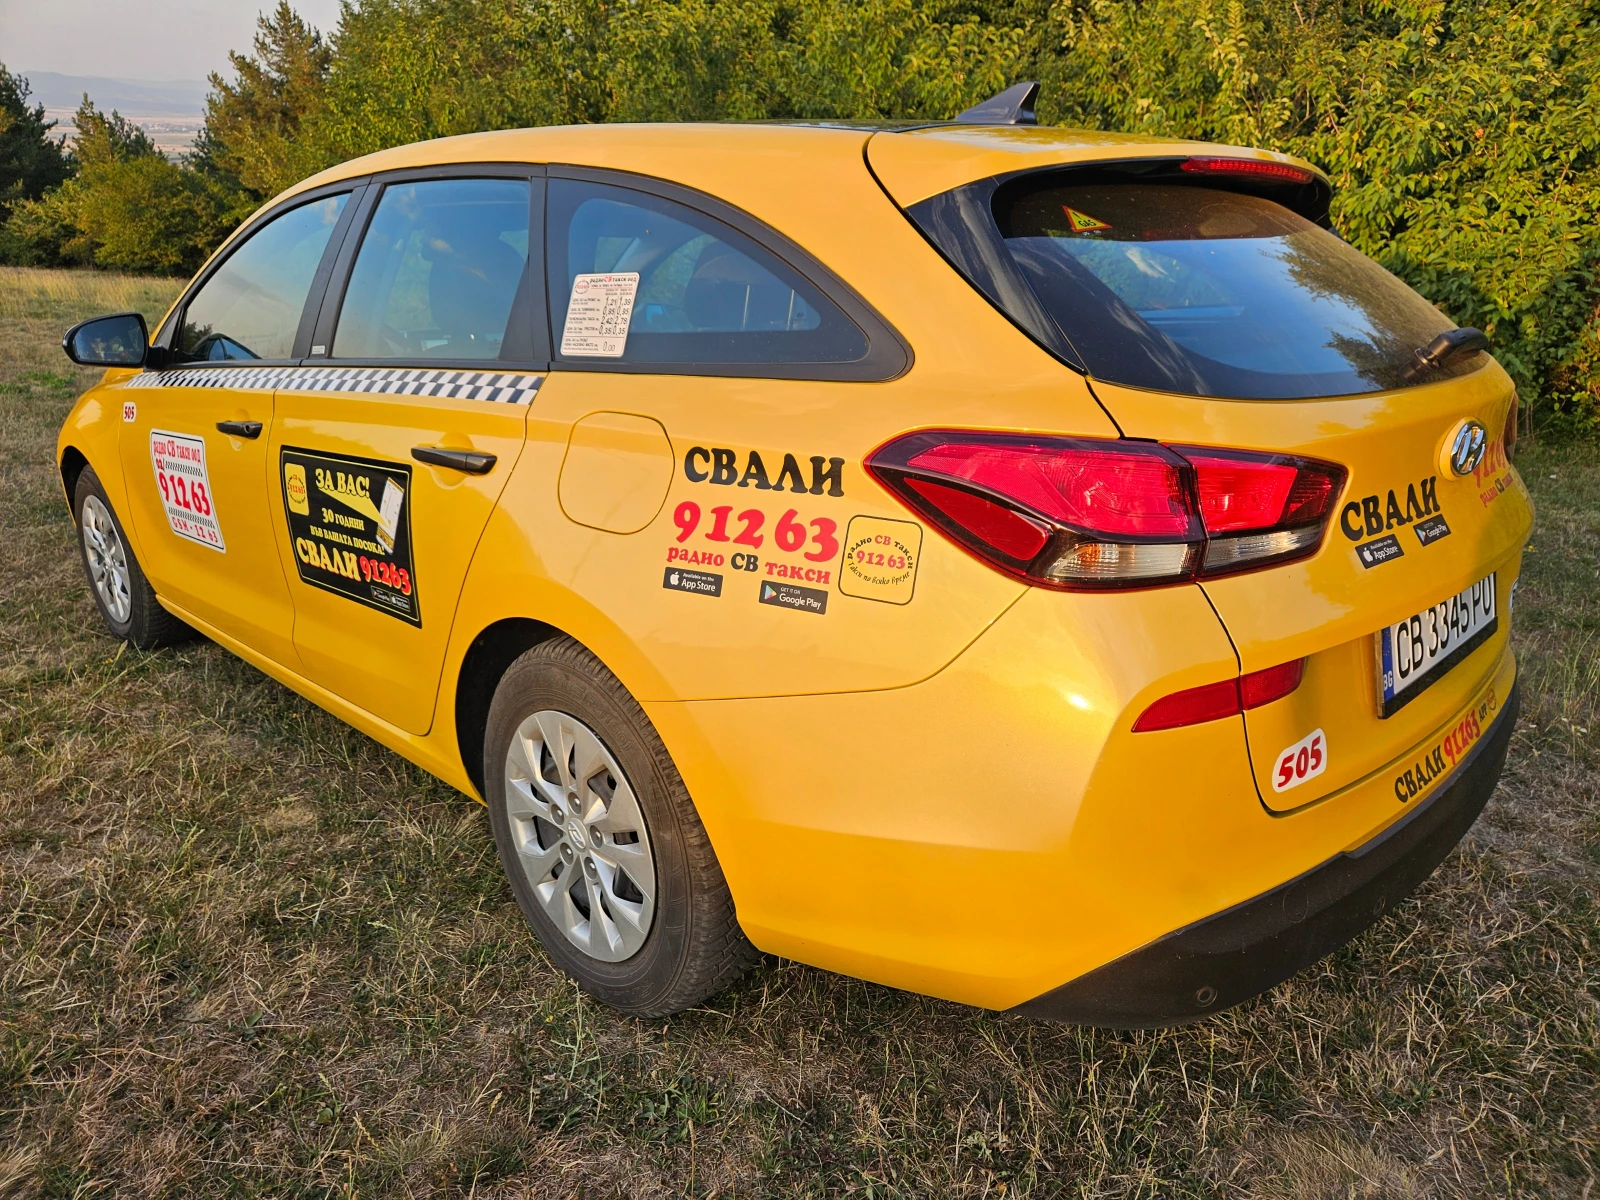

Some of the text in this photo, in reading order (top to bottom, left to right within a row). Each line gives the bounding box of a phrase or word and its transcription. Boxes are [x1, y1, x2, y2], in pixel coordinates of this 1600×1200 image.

[124, 406, 134, 419] 505
[167, 440, 175, 457] СВ
[315, 468, 370, 498] ЗА ВАС!
[684, 446, 845, 497] СВАЛИ
[322, 507, 365, 531] 30 ГОДИНИ
[1341, 476, 1440, 541] СВАЛИ
[310, 525, 385, 556] ВЪВ ВАШАТА ПОСОКА!
[1426, 527, 1440, 537] Google
[296, 537, 362, 582] СВАЛИ
[667, 547, 831, 584] радио СВ такси
[848, 535, 913, 569] радио СВ такси
[1374, 545, 1399, 560] App Store
[359, 556, 411, 595] 91263
[681, 579, 716, 592] App Store
[779, 593, 822, 610] Google Play
[1428, 593, 1470, 657] 3345
[1383, 670, 1393, 691] BG
[1277, 736, 1322, 788] 505
[1394, 745, 1446, 803] СВАЛИ
[1443, 709, 1481, 765] 91263
